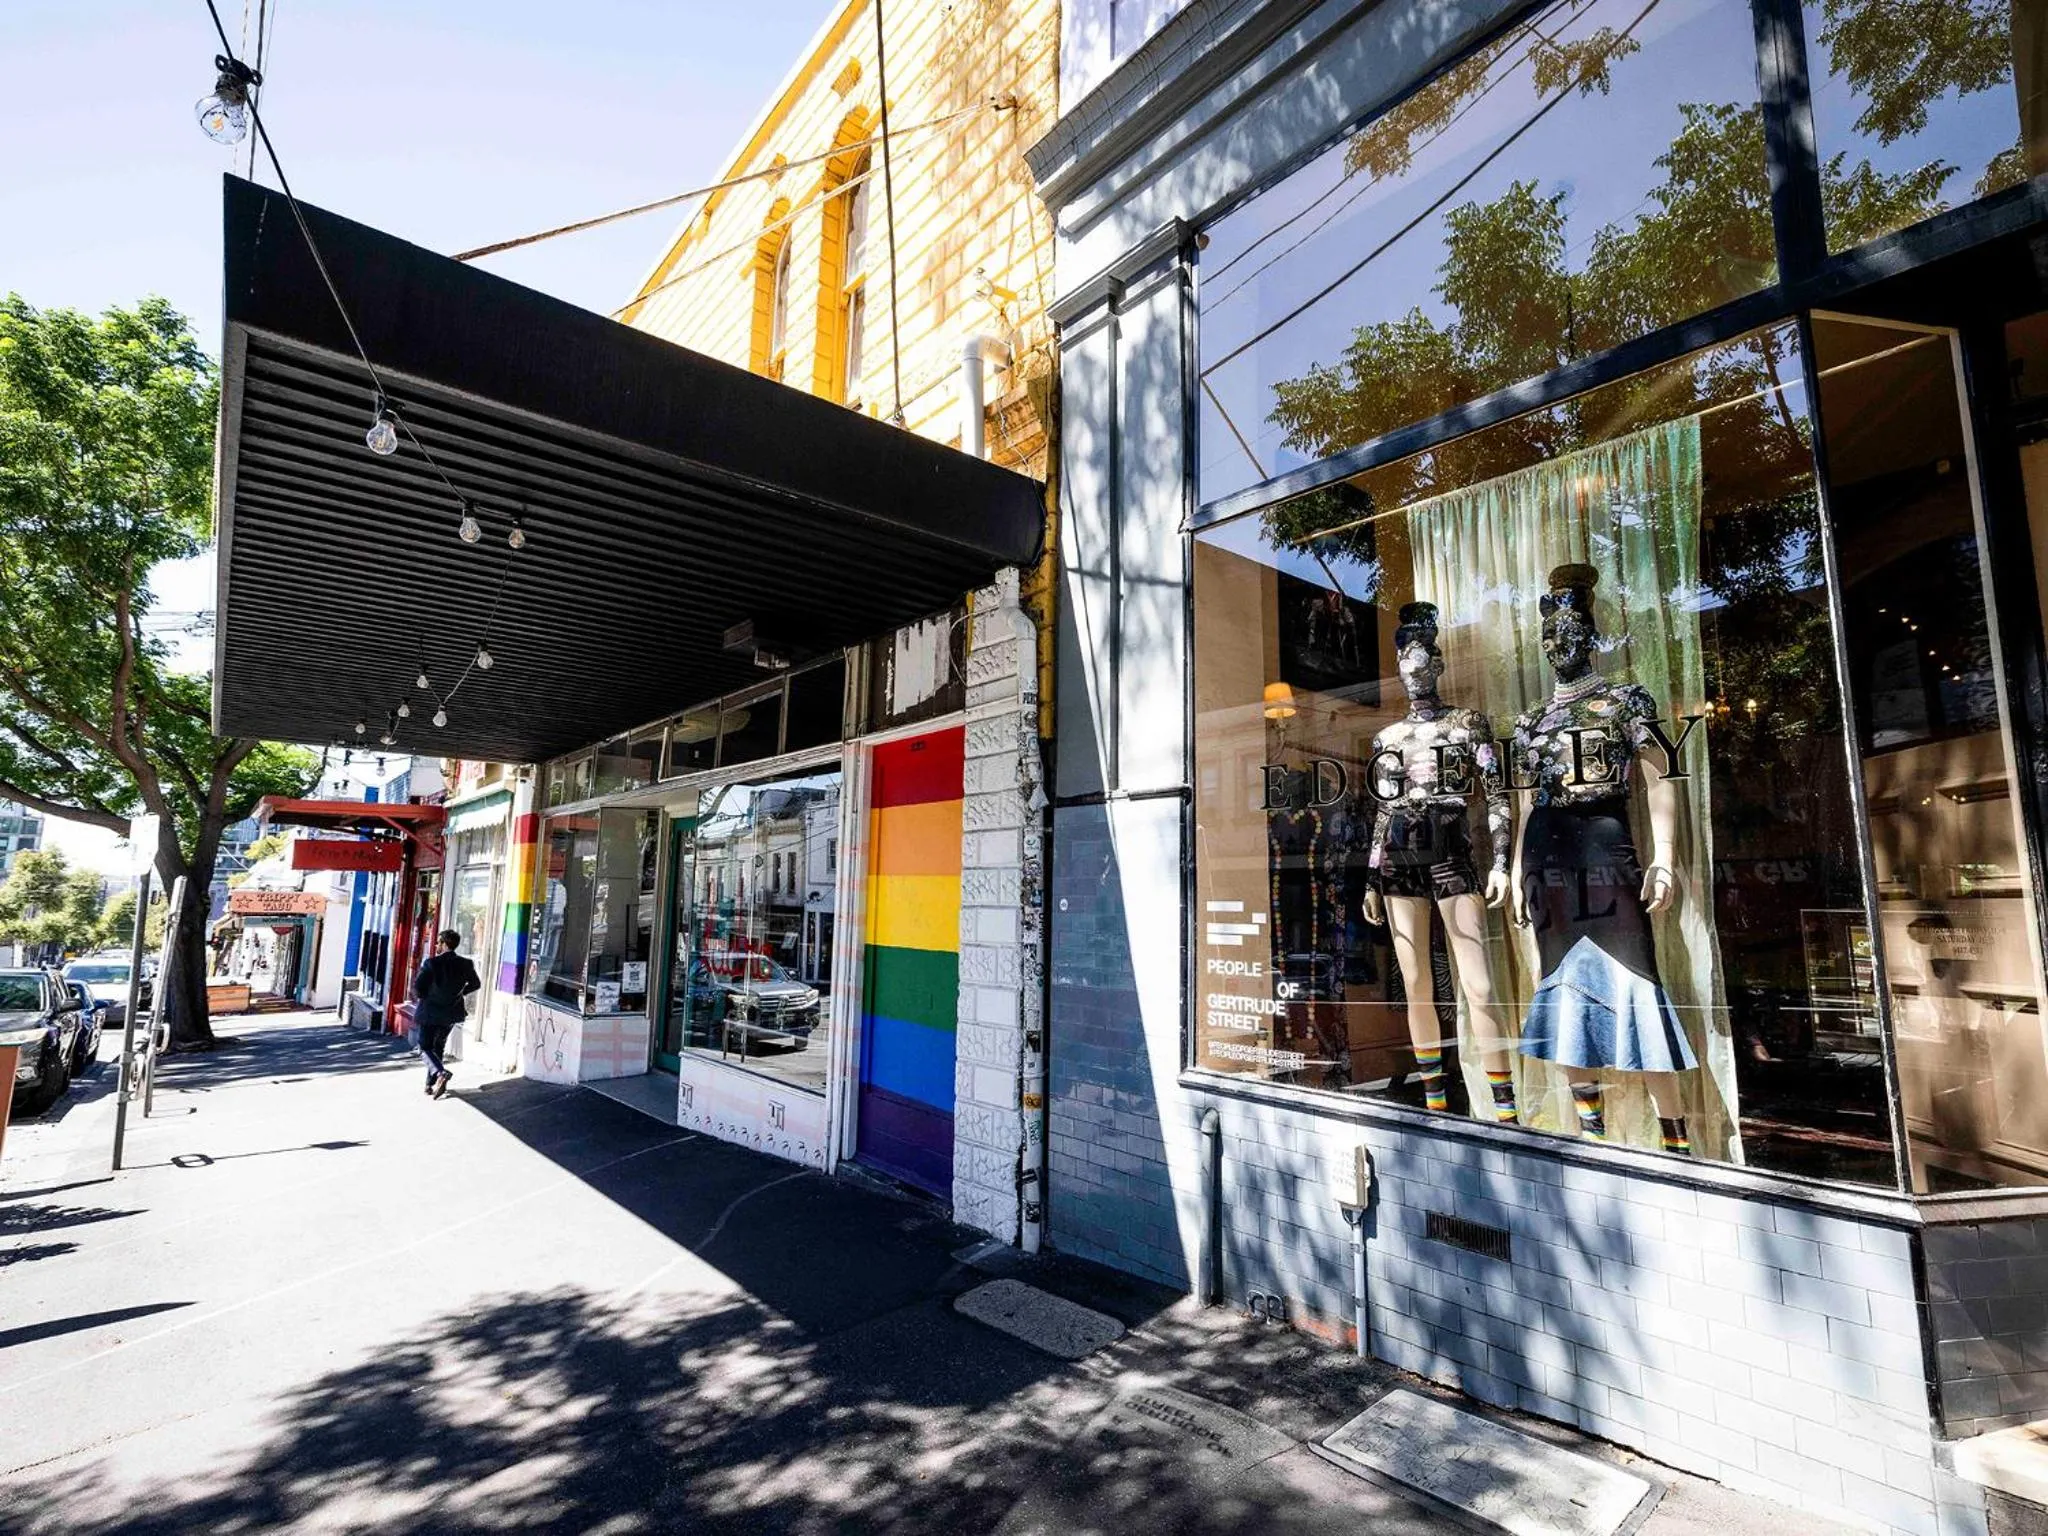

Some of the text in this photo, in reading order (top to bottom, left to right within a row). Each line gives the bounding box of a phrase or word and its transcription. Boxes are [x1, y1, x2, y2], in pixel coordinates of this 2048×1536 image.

[1260, 714, 1704, 811] EDGELEY
[256, 893, 301, 903] TRIPPY
[1207, 959, 1262, 977] PEOPLE
[1277, 981, 1299, 998] OF
[1207, 993, 1286, 1016] GERTRUDE
[1207, 1010, 1262, 1031] STREET
